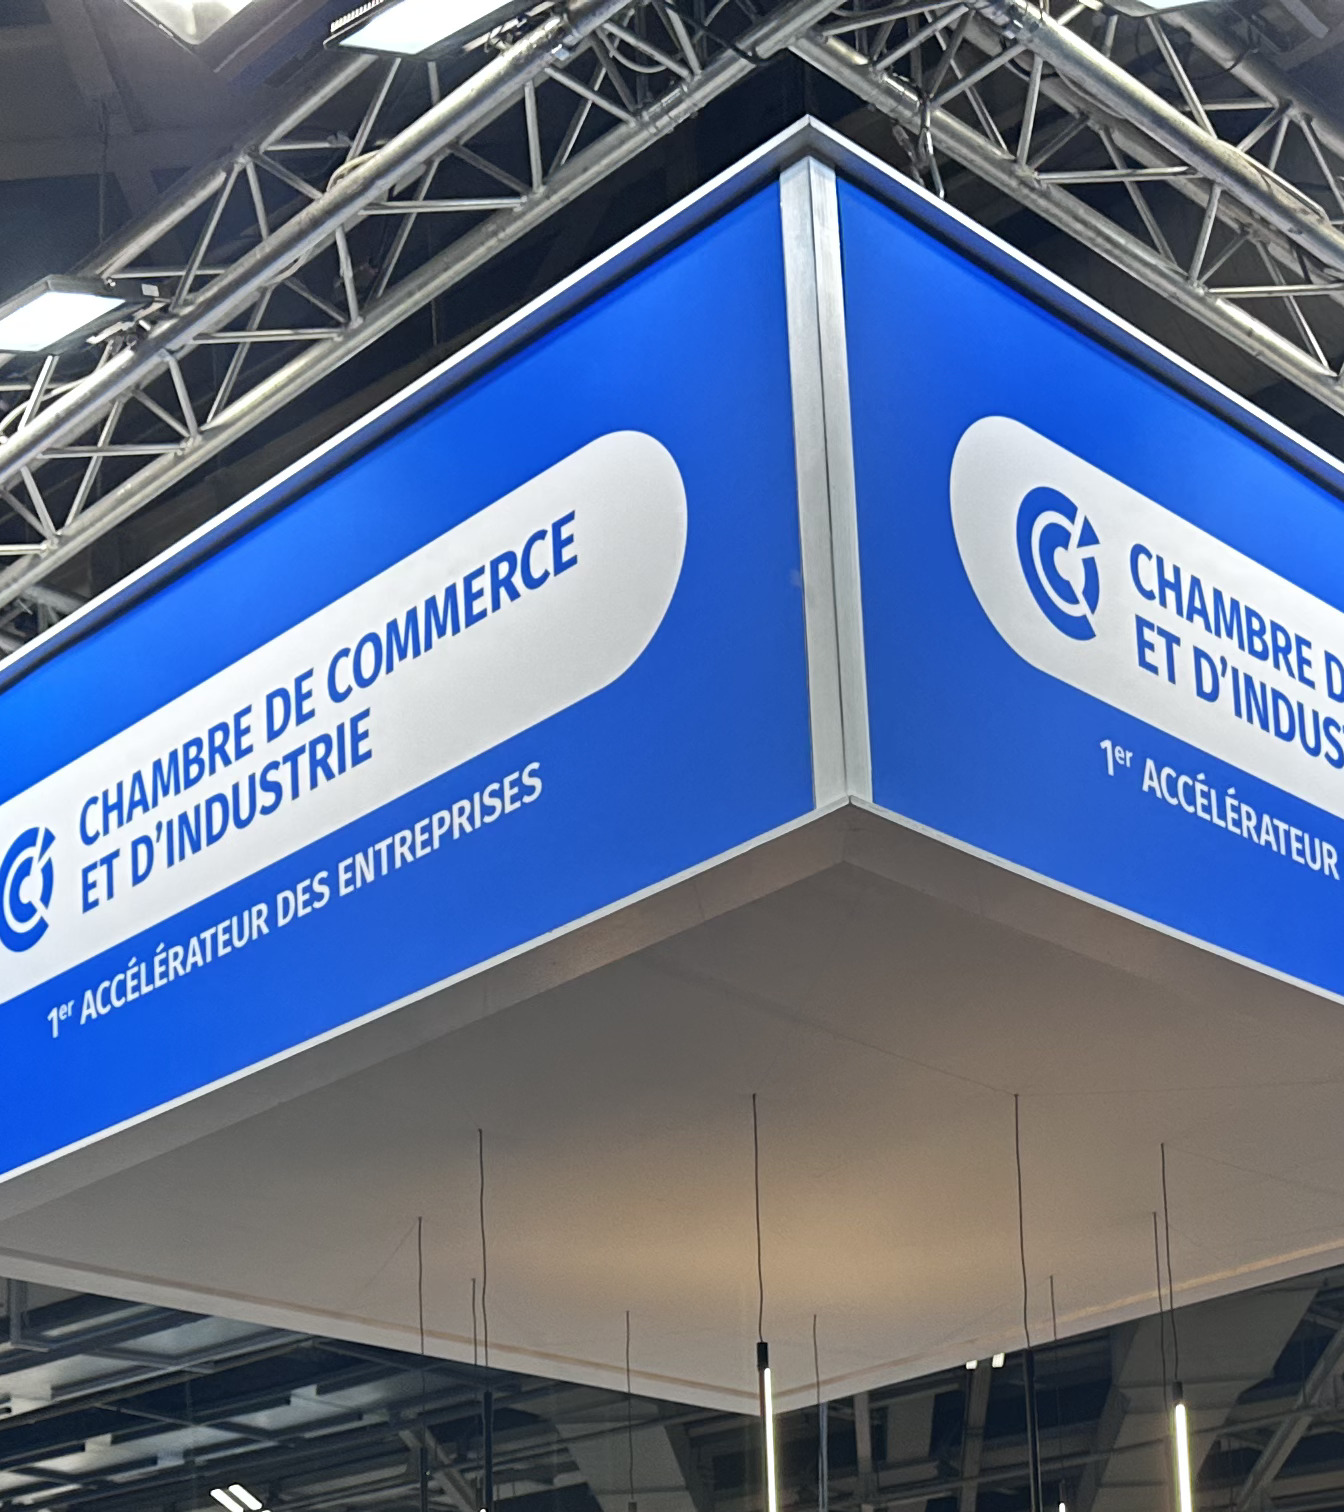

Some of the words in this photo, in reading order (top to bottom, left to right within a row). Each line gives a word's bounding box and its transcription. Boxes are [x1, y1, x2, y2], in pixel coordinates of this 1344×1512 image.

[80, 704, 255, 846] CHAMBRE
[265, 668, 316, 739] DE
[327, 509, 579, 703] COMMERCE
[1130, 543, 1315, 690] CHAMBRE
[1134, 613, 1181, 685] ET
[82, 847, 121, 914] ET
[131, 707, 373, 889] D'INDUSTRIE
[1100, 739, 1133, 776] 1er
[1142, 758, 1340, 881] ACCÉLÉRATEUR
[46, 998, 75, 1038] 1er
[79, 902, 269, 1025] ACCÉLÉRATEUR
[276, 870, 331, 929] DES
[338, 760, 544, 897] ENTREPRISES
